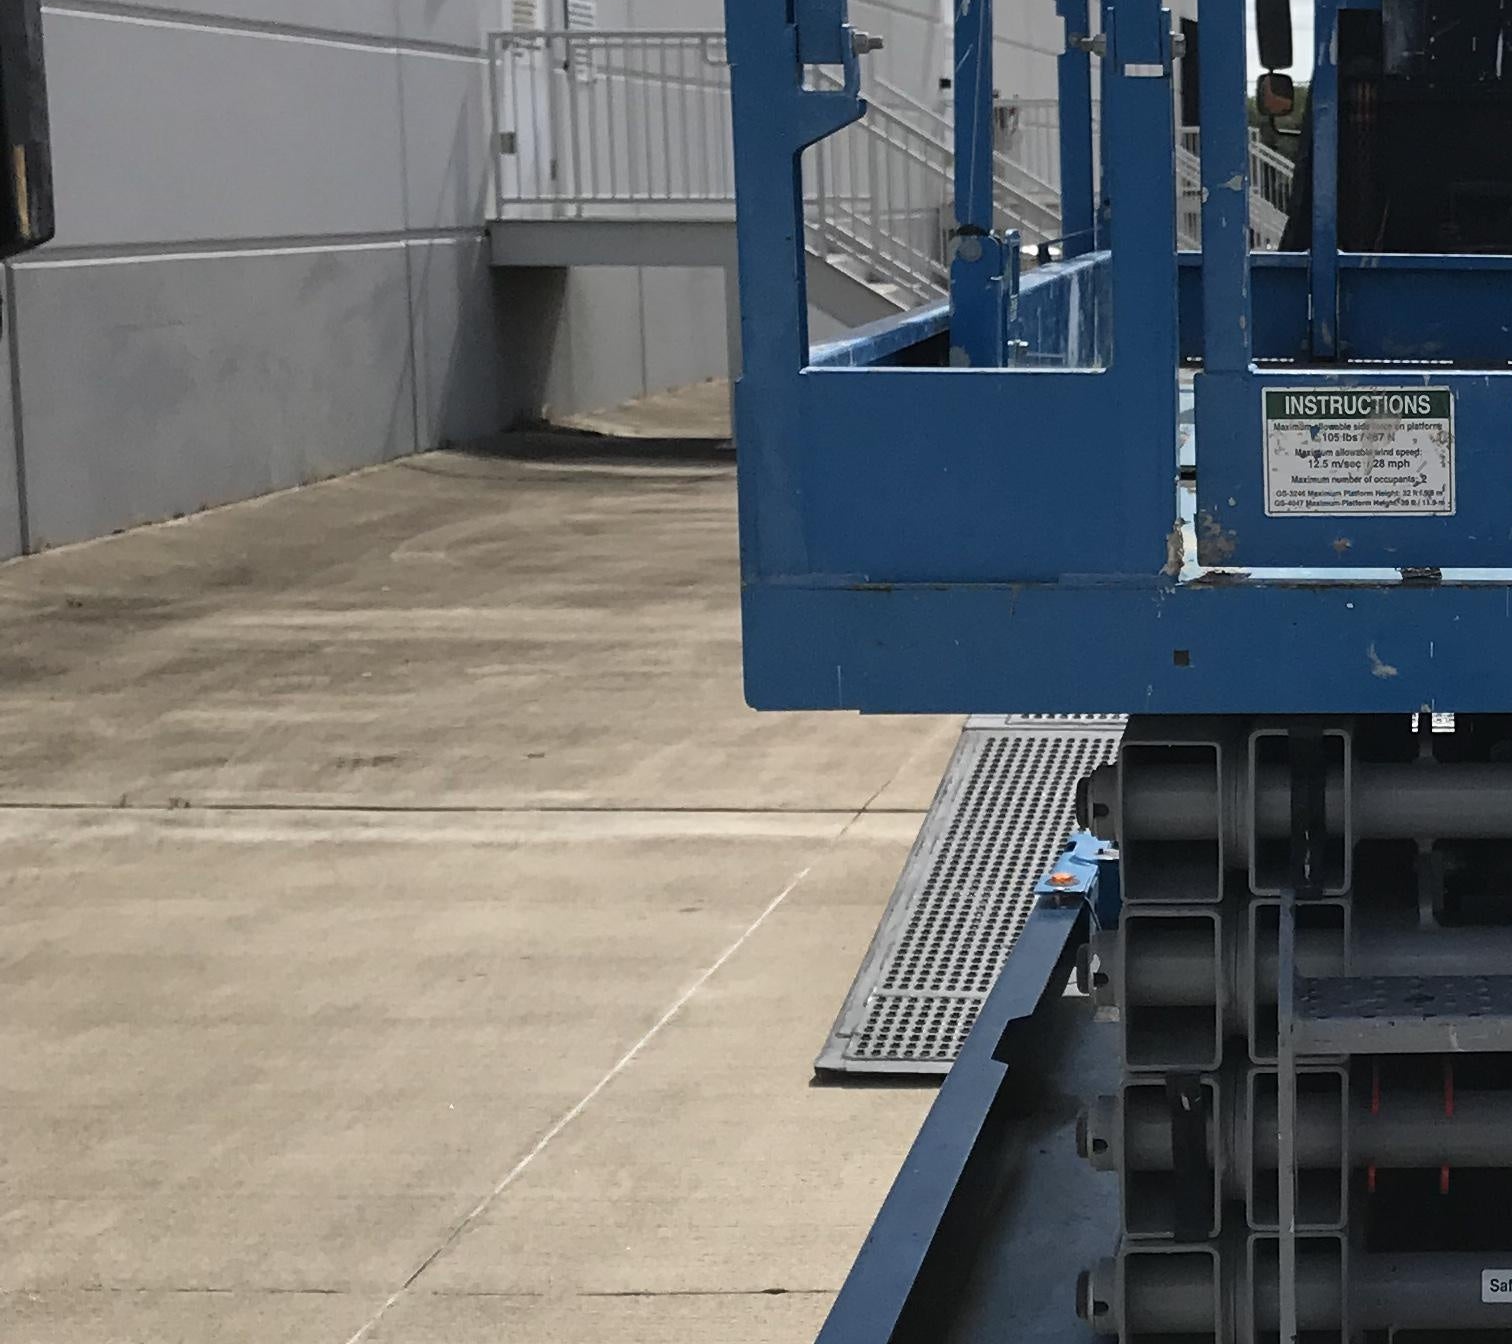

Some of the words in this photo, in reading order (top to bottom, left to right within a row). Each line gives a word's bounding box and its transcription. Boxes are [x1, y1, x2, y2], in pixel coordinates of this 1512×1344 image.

[1285, 394, 1431, 415] INSTRUCTIONS
[1273, 423, 1310, 431] Maximum
[1322, 433, 1339, 442] 105
[1342, 433, 1358, 442] lbs
[1366, 433, 1384, 442] 67
[1308, 459, 1328, 468] 12.5
[1330, 459, 1362, 468] m/sec
[1372, 459, 1386, 468] 28
[1387, 459, 1410, 470] mph
[1291, 475, 1330, 484] Maximum
[1331, 475, 1362, 484] number
[1364, 475, 1372, 484] of
